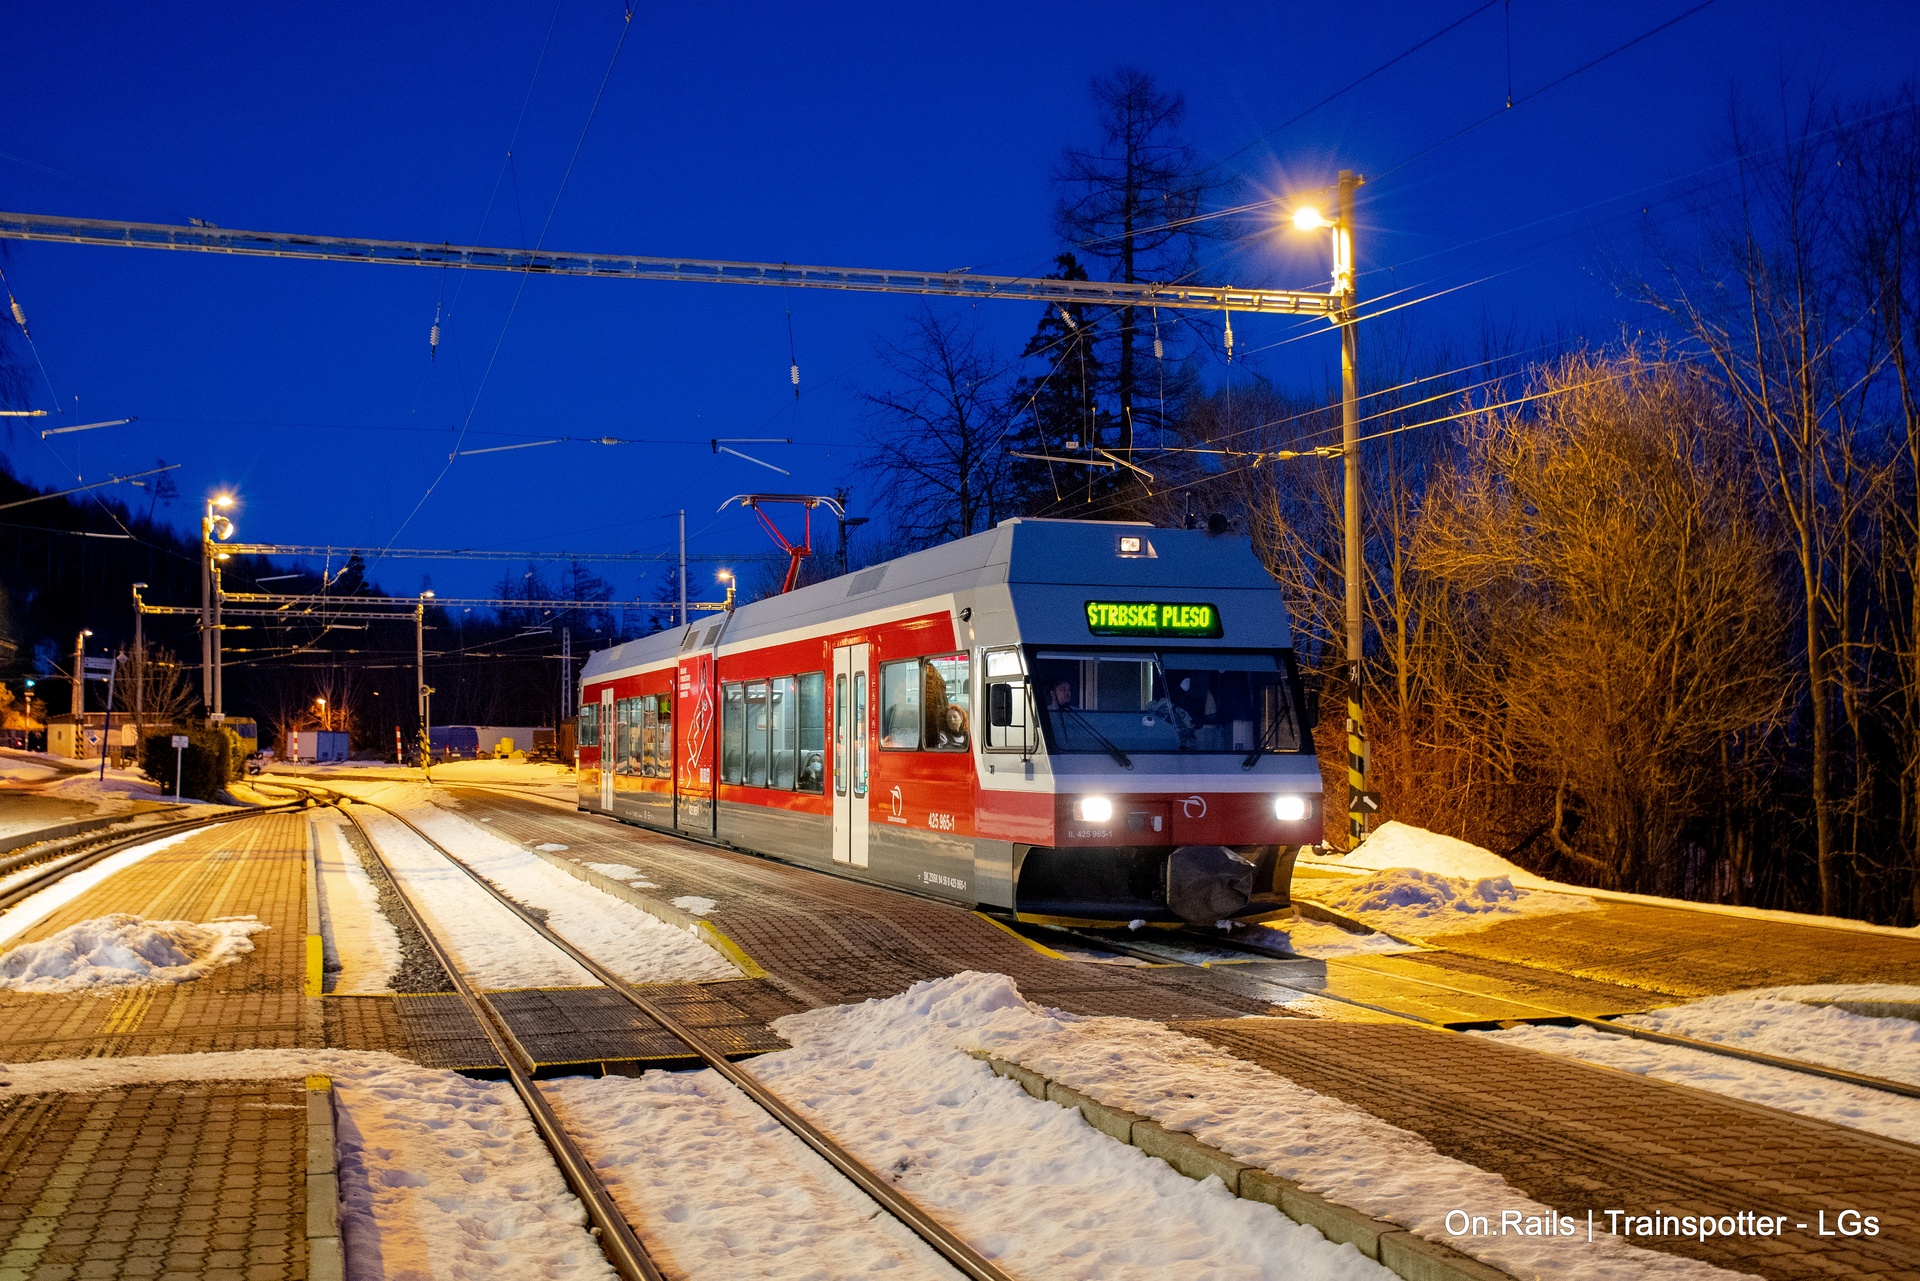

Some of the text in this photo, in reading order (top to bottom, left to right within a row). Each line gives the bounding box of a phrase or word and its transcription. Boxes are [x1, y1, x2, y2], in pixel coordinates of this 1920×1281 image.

[1162, 606, 1210, 627] PLESO
[928, 812, 955, 831] 425 965-1
[1076, 830, 1091, 838] 425
[1092, 830, 1112, 838] 965-1
